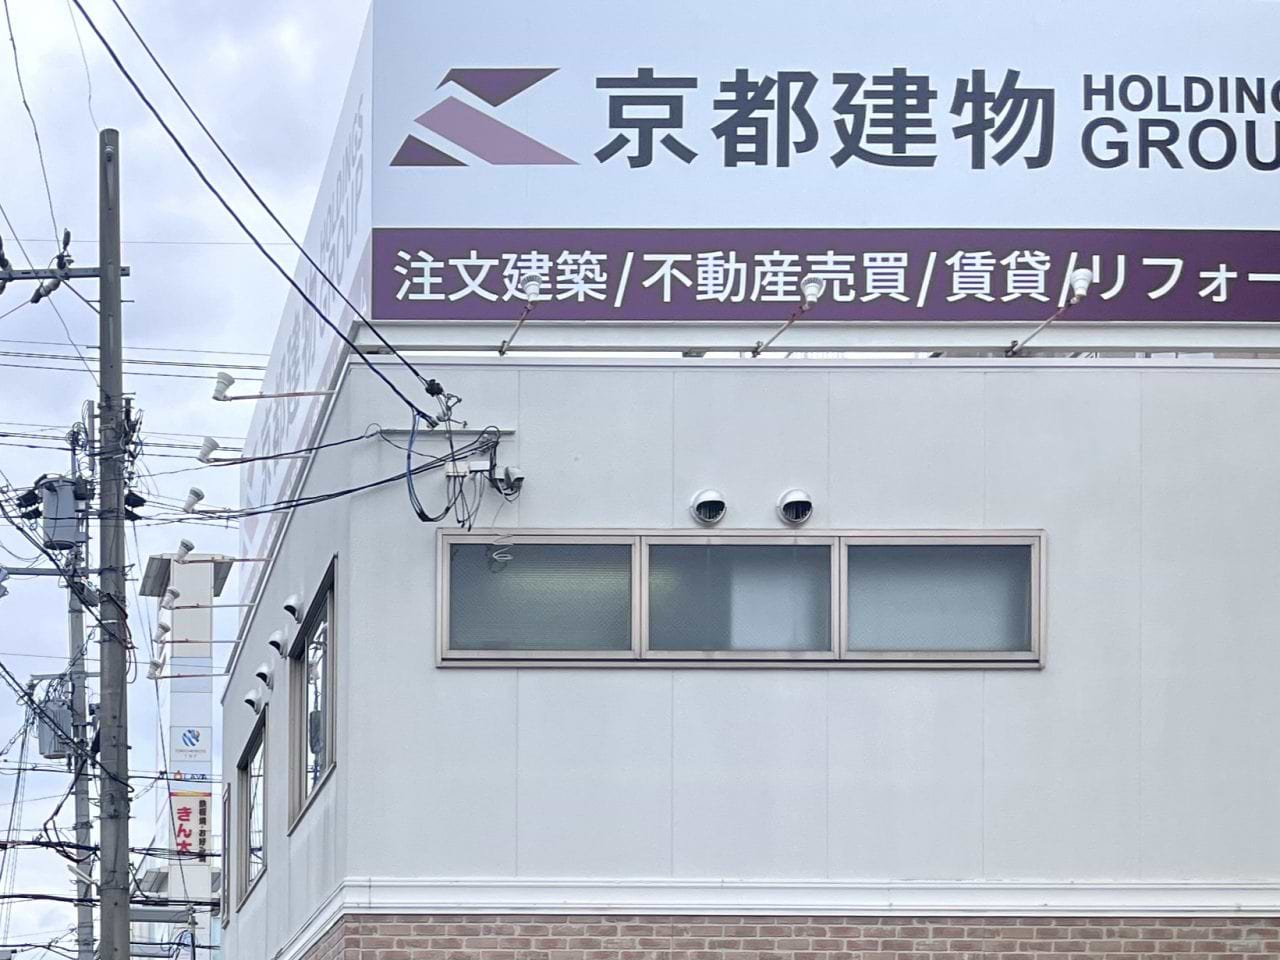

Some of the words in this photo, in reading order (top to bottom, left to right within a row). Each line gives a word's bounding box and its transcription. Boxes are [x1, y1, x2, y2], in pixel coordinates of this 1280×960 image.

[594, 67, 1056, 170] 京都建物
[1083, 74, 1280, 114] HOLDIN
[1081, 117, 1280, 171] GROU
